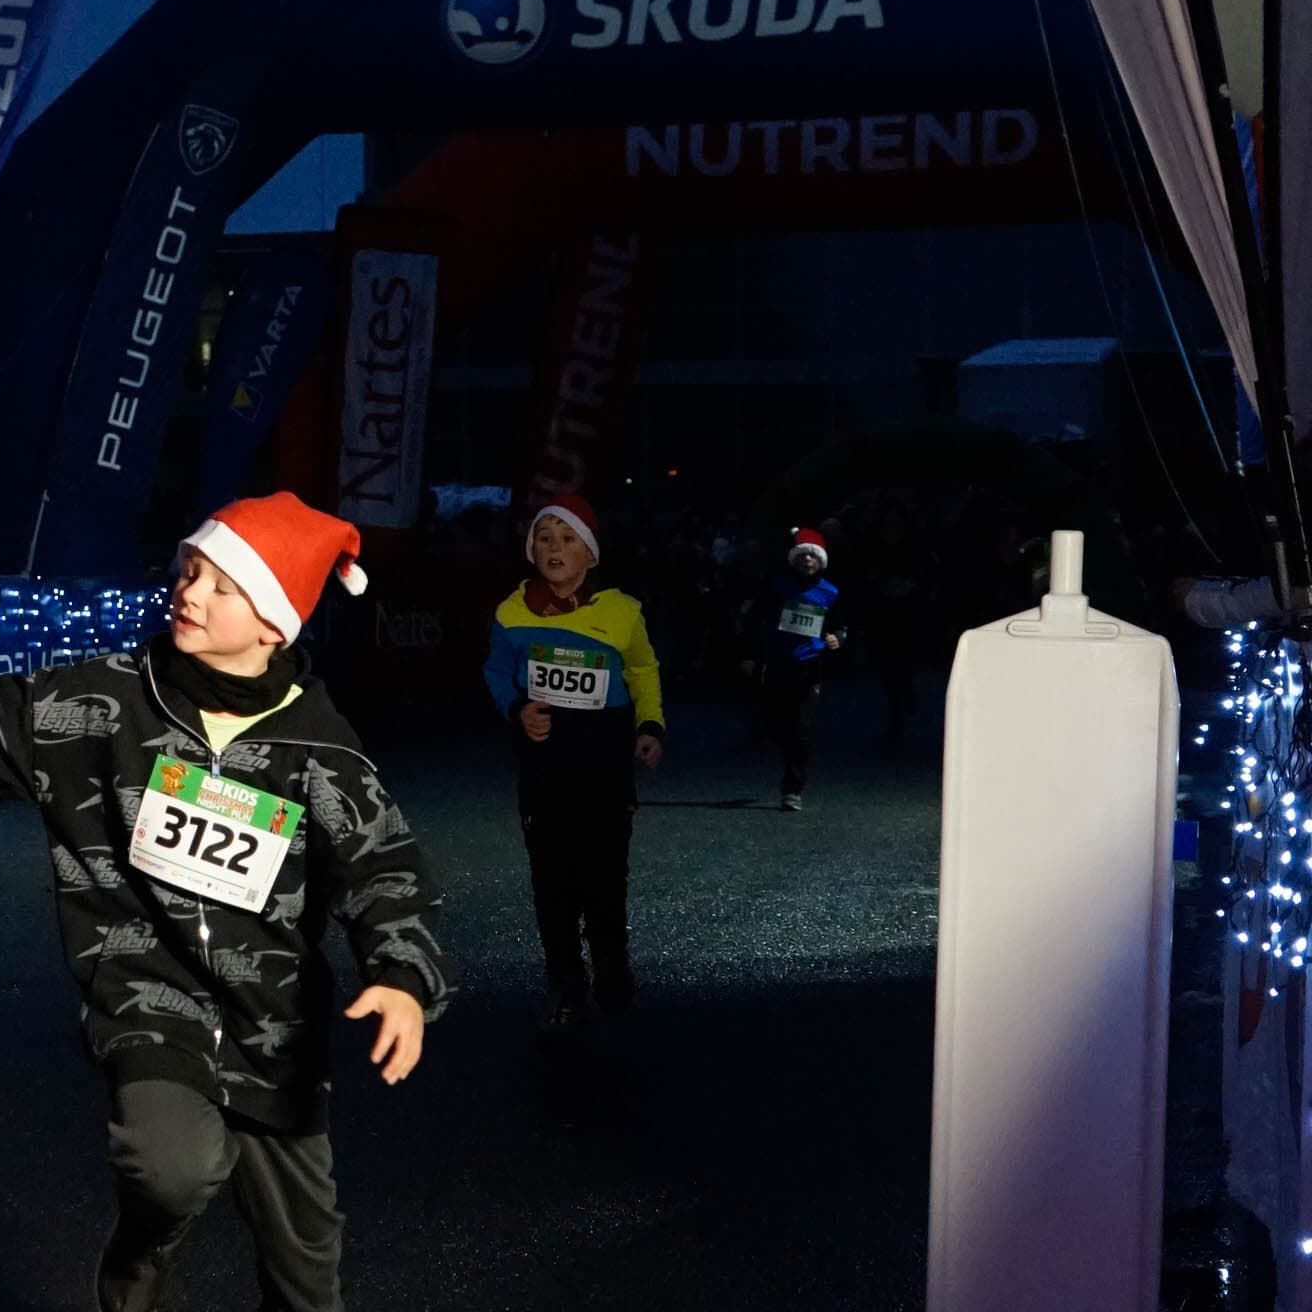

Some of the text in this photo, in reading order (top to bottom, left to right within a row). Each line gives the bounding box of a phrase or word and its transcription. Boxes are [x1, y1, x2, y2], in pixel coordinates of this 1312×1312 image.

[624, 106, 1040, 177] NUTREND
[96, 185, 198, 472] PEUGEOT
[249, 280, 304, 380] VARTA
[343, 277, 410, 502] Nartes
[534, 665, 596, 695] 3050
[222, 783, 259, 806] KIDS
[155, 806, 259, 875] 3122
